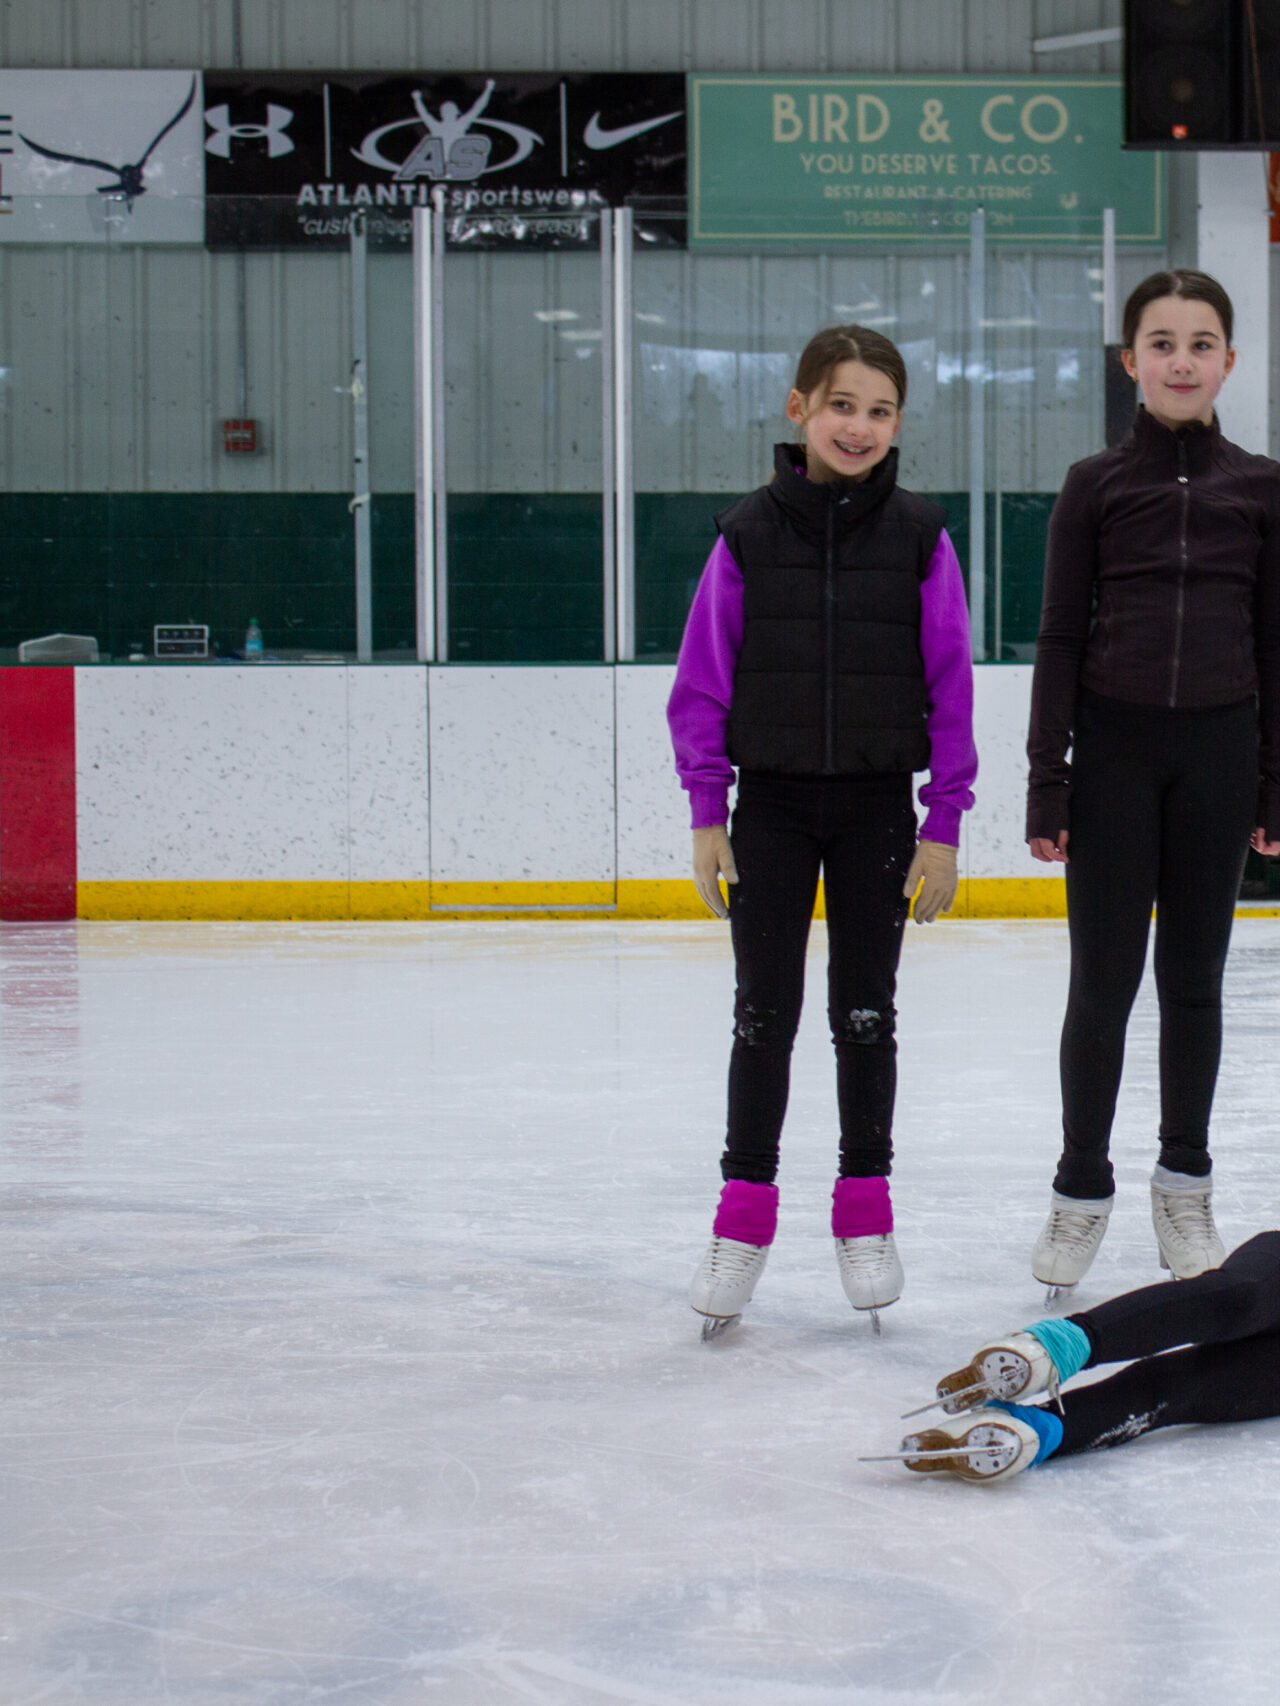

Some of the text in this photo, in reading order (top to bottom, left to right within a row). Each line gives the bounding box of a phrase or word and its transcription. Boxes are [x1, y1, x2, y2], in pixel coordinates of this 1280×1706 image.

[772, 94, 1084, 143] BIRD & CO.
[800, 153, 1058, 175] YOU DESERVE TACOS.
[823, 185, 928, 200] RESTAURANT
[953, 185, 1033, 200] CATERING
